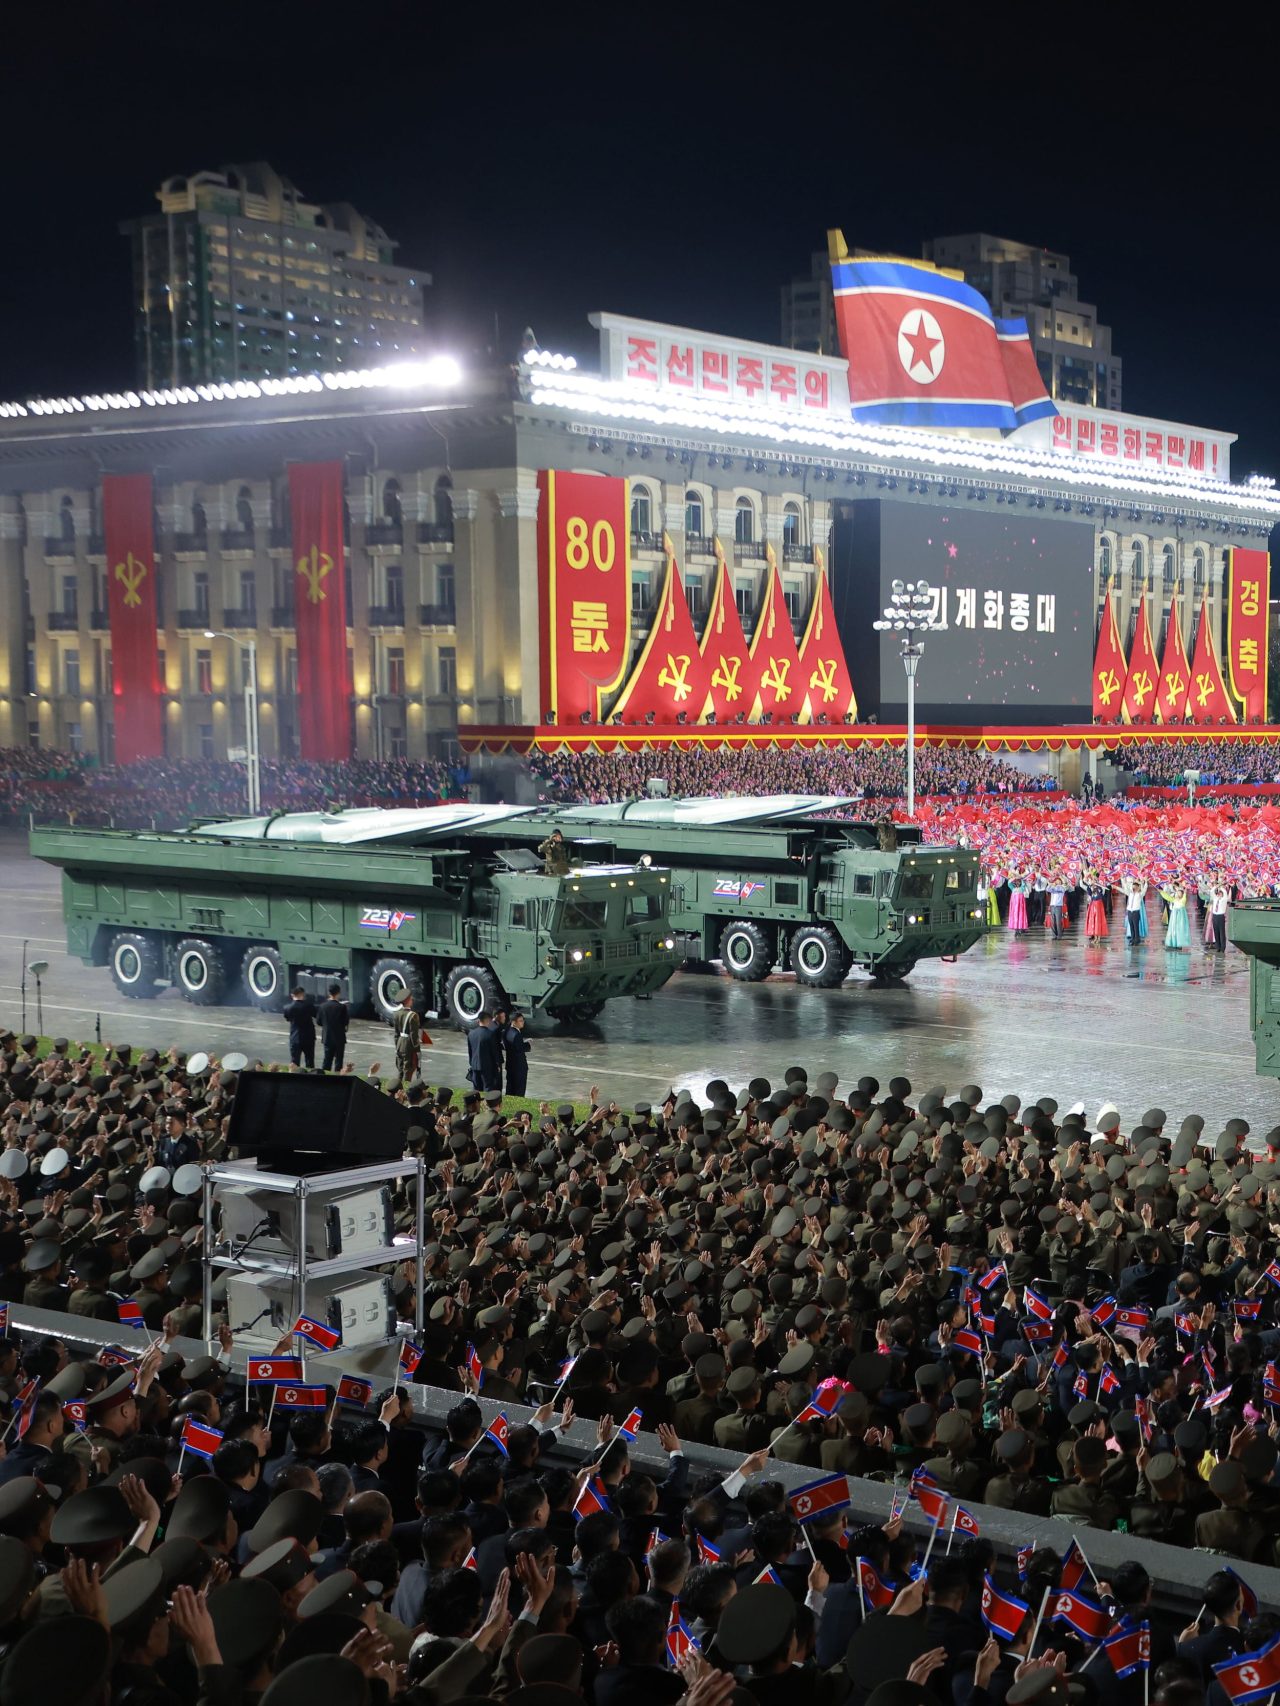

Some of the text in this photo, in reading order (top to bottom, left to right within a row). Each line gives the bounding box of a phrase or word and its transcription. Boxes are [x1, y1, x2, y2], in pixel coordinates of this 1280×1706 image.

[627, 336, 828, 409] 조선민주주의
[565, 516, 615, 653] 80 돐
[715, 880, 740, 891] 724
[363, 908, 391, 922] 723
